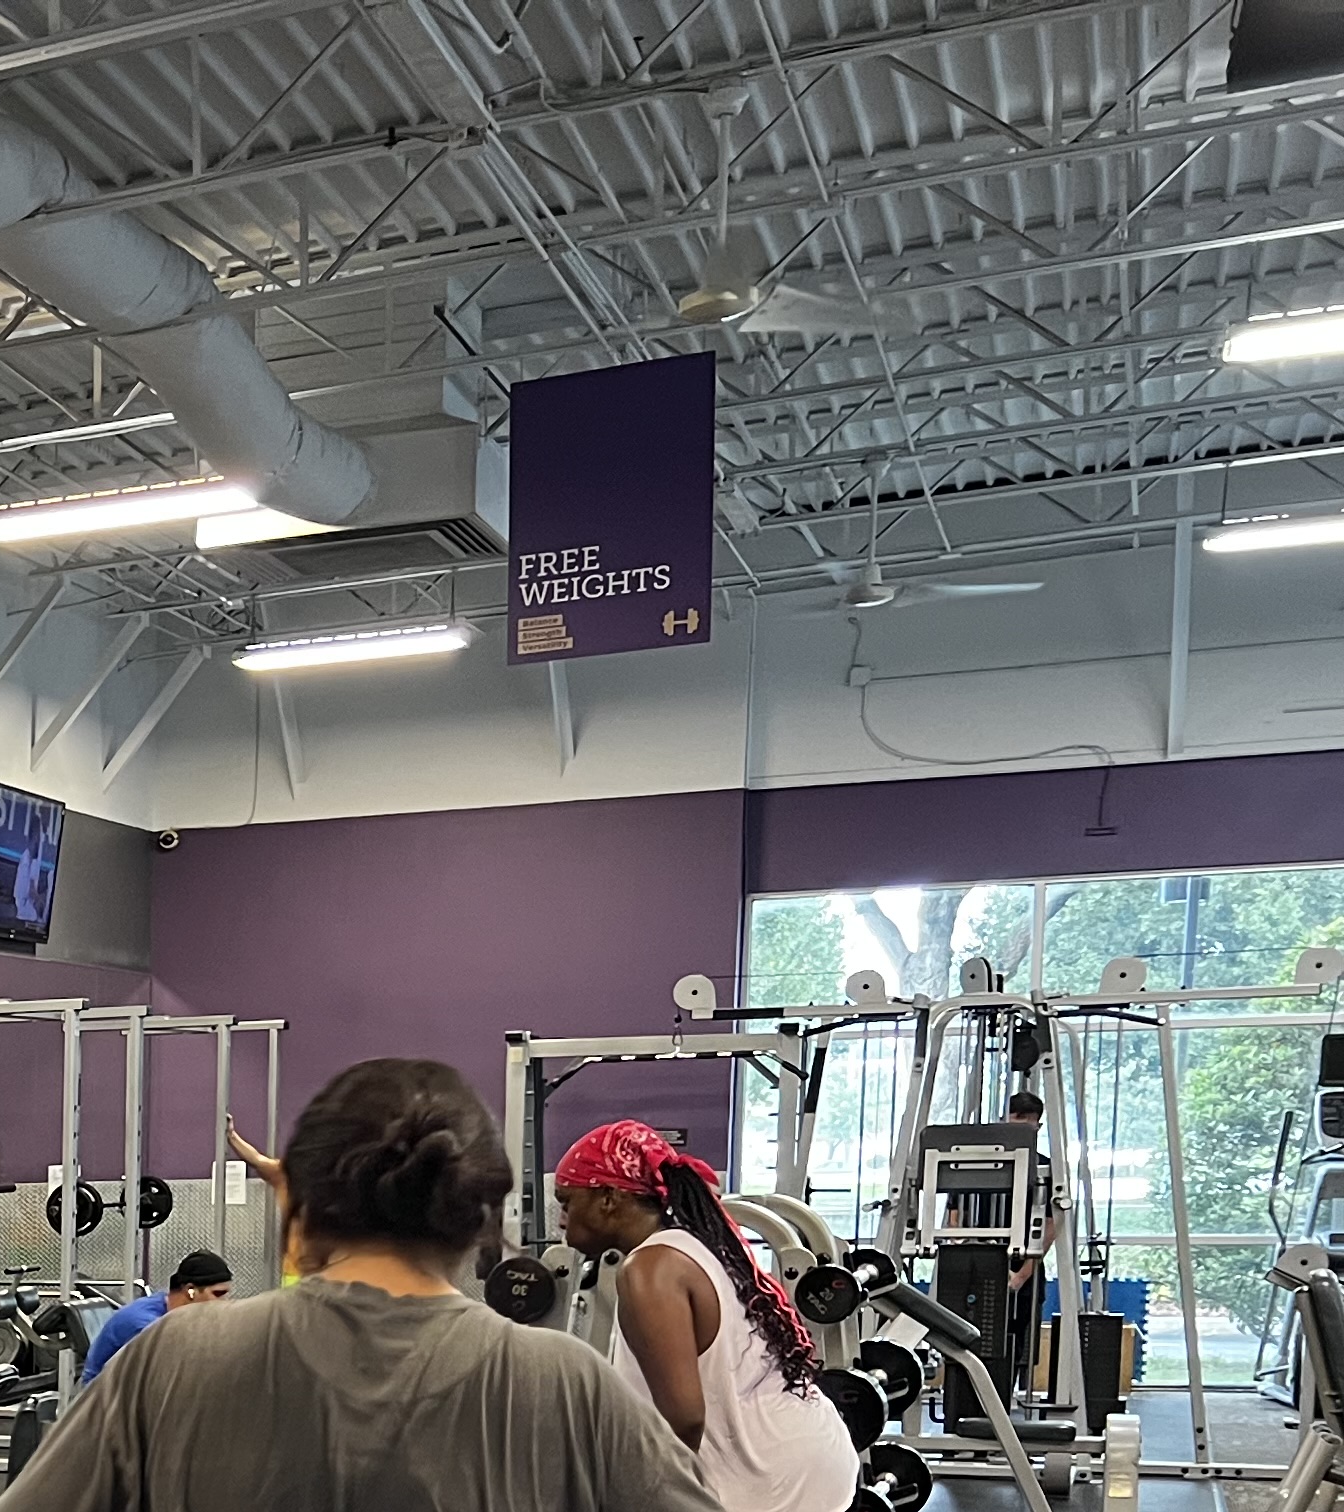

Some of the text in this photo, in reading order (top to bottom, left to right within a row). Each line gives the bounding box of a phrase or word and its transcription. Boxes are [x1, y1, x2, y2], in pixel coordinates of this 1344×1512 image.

[518, 545, 600, 580] FREE
[519, 565, 671, 606] WEIGHTS
[522, 629, 562, 640] Strength
[506, 1270, 539, 1282] TAG
[512, 1284, 529, 1296] 30
